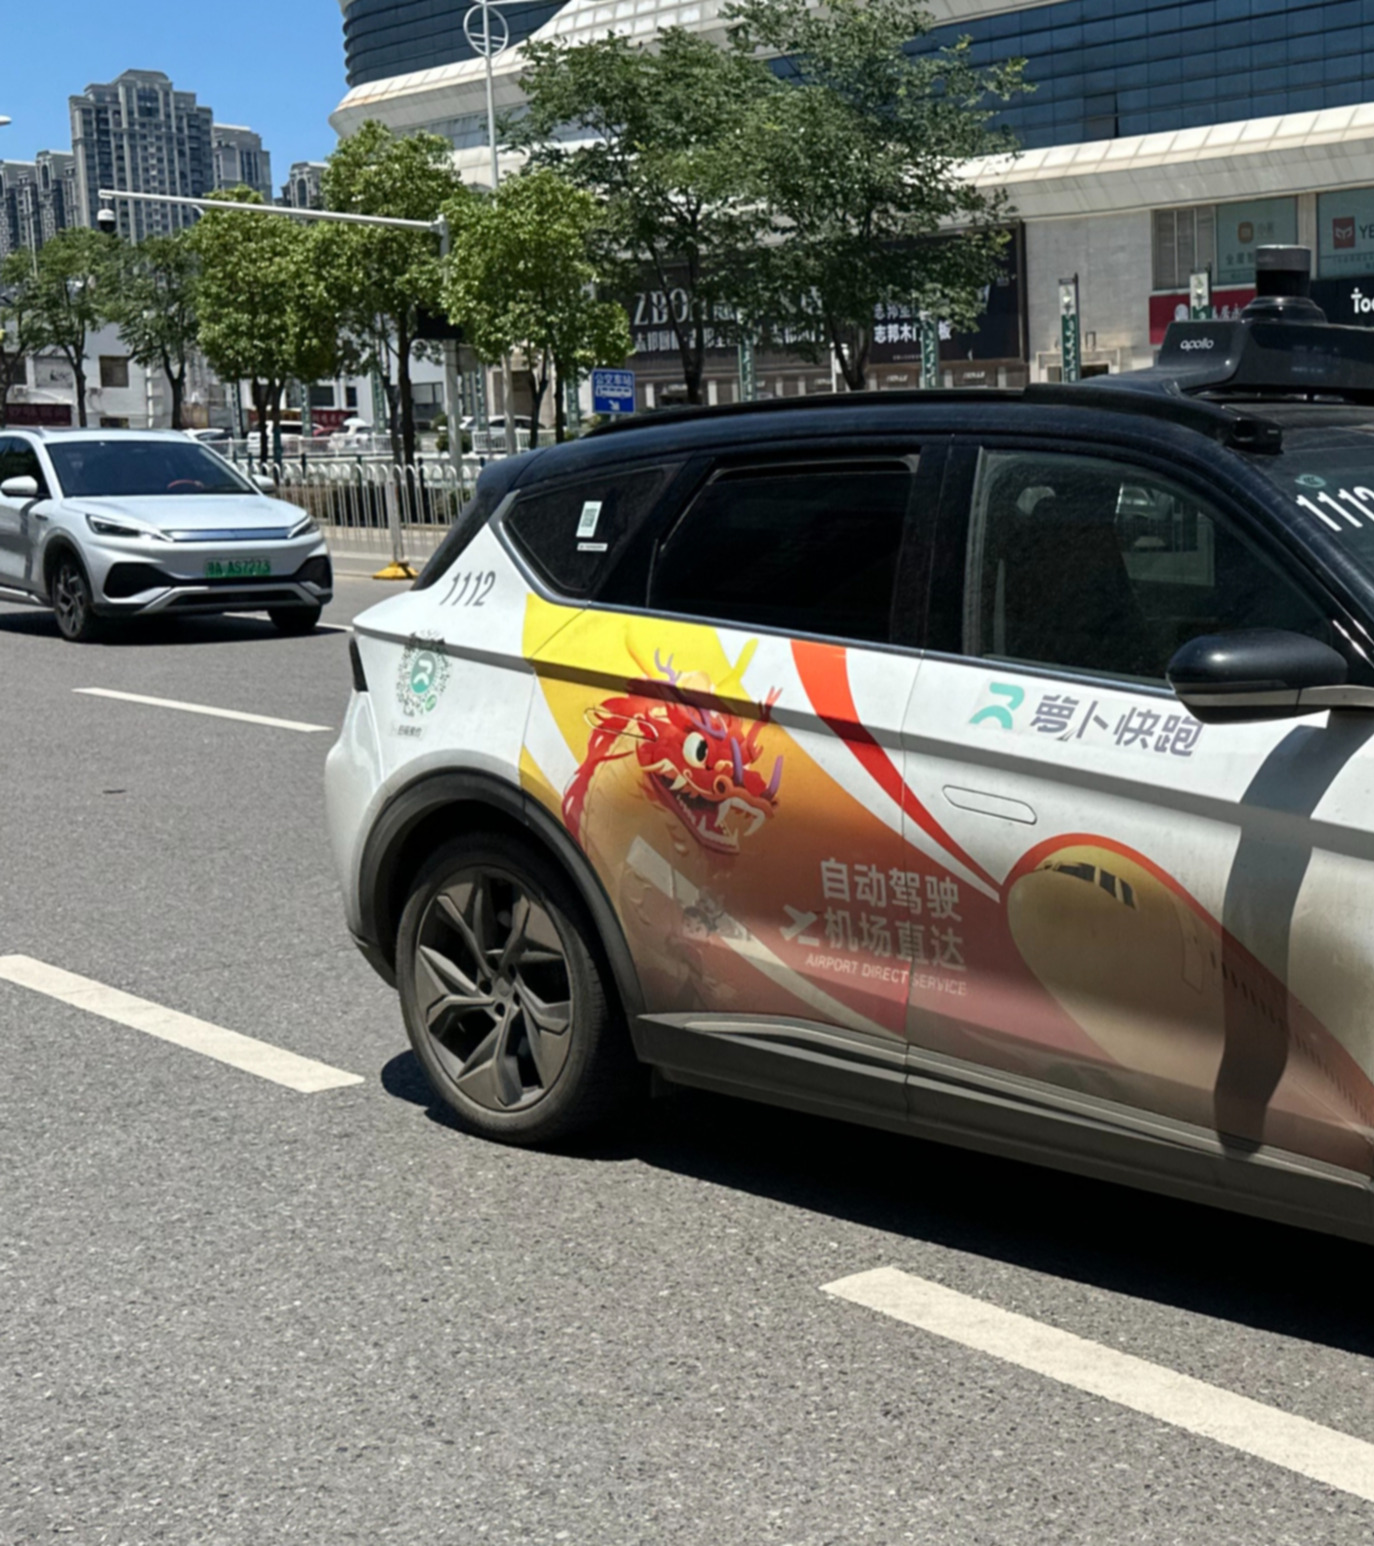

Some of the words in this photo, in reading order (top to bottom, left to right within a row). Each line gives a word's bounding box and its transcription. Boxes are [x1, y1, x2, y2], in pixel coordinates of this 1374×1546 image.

[873, 320, 952, 344] 志邦木门板
[1180, 337, 1214, 351] apollo
[439, 570, 496, 607] 1112
[1030, 694, 1204, 757] 萝卜快跑
[820, 858, 962, 922] 自动驾驶
[824, 906, 967, 972] 机场直达
[805, 953, 858, 976] AIRPORT
[861, 966, 908, 985] DIRECT
[912, 972, 967, 996] SERVICE
